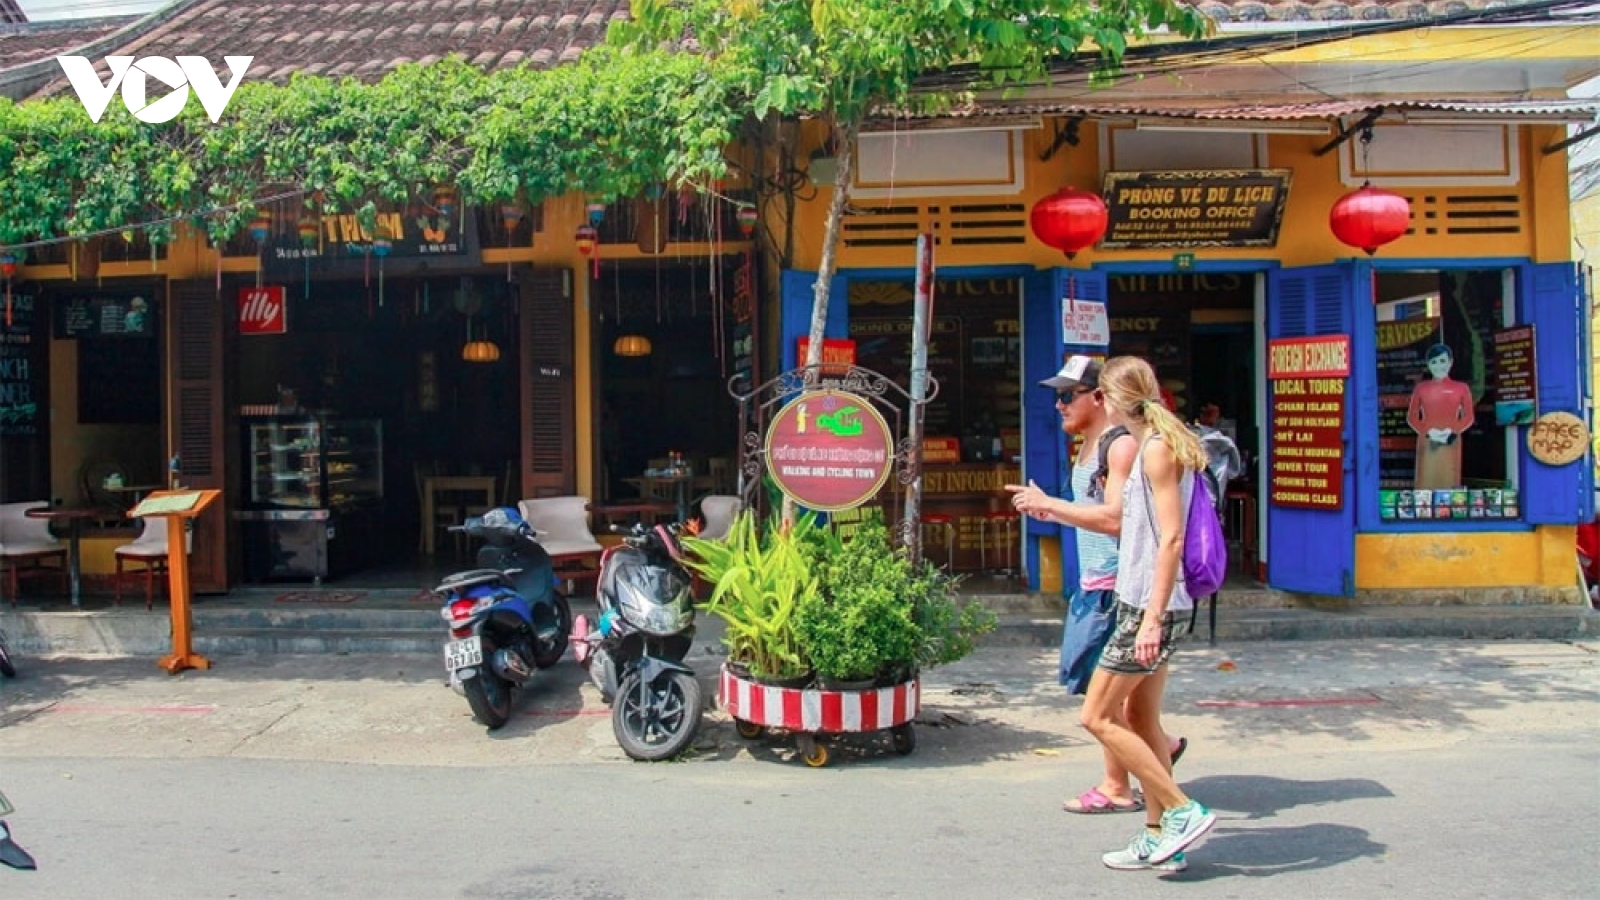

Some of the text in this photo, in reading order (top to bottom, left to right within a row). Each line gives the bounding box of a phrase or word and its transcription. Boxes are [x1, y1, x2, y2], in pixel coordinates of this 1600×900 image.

[1206, 187, 1230, 203] DU
[1129, 205, 1257, 220] BOOKING OFFICE
[241, 292, 279, 329] illy
[1271, 344, 1303, 374] FOREIGN
[1305, 341, 1347, 372] EXCHANGE
[1274, 378, 1344, 395] LOCAL TOURS
[1532, 421, 1581, 440] FREE
[1532, 439, 1573, 454] MAP
[782, 465, 875, 479] WALKING AND CYCLING TOWN
[1304, 463, 1328, 473] TOUR
[1307, 478, 1328, 488] TOUR
